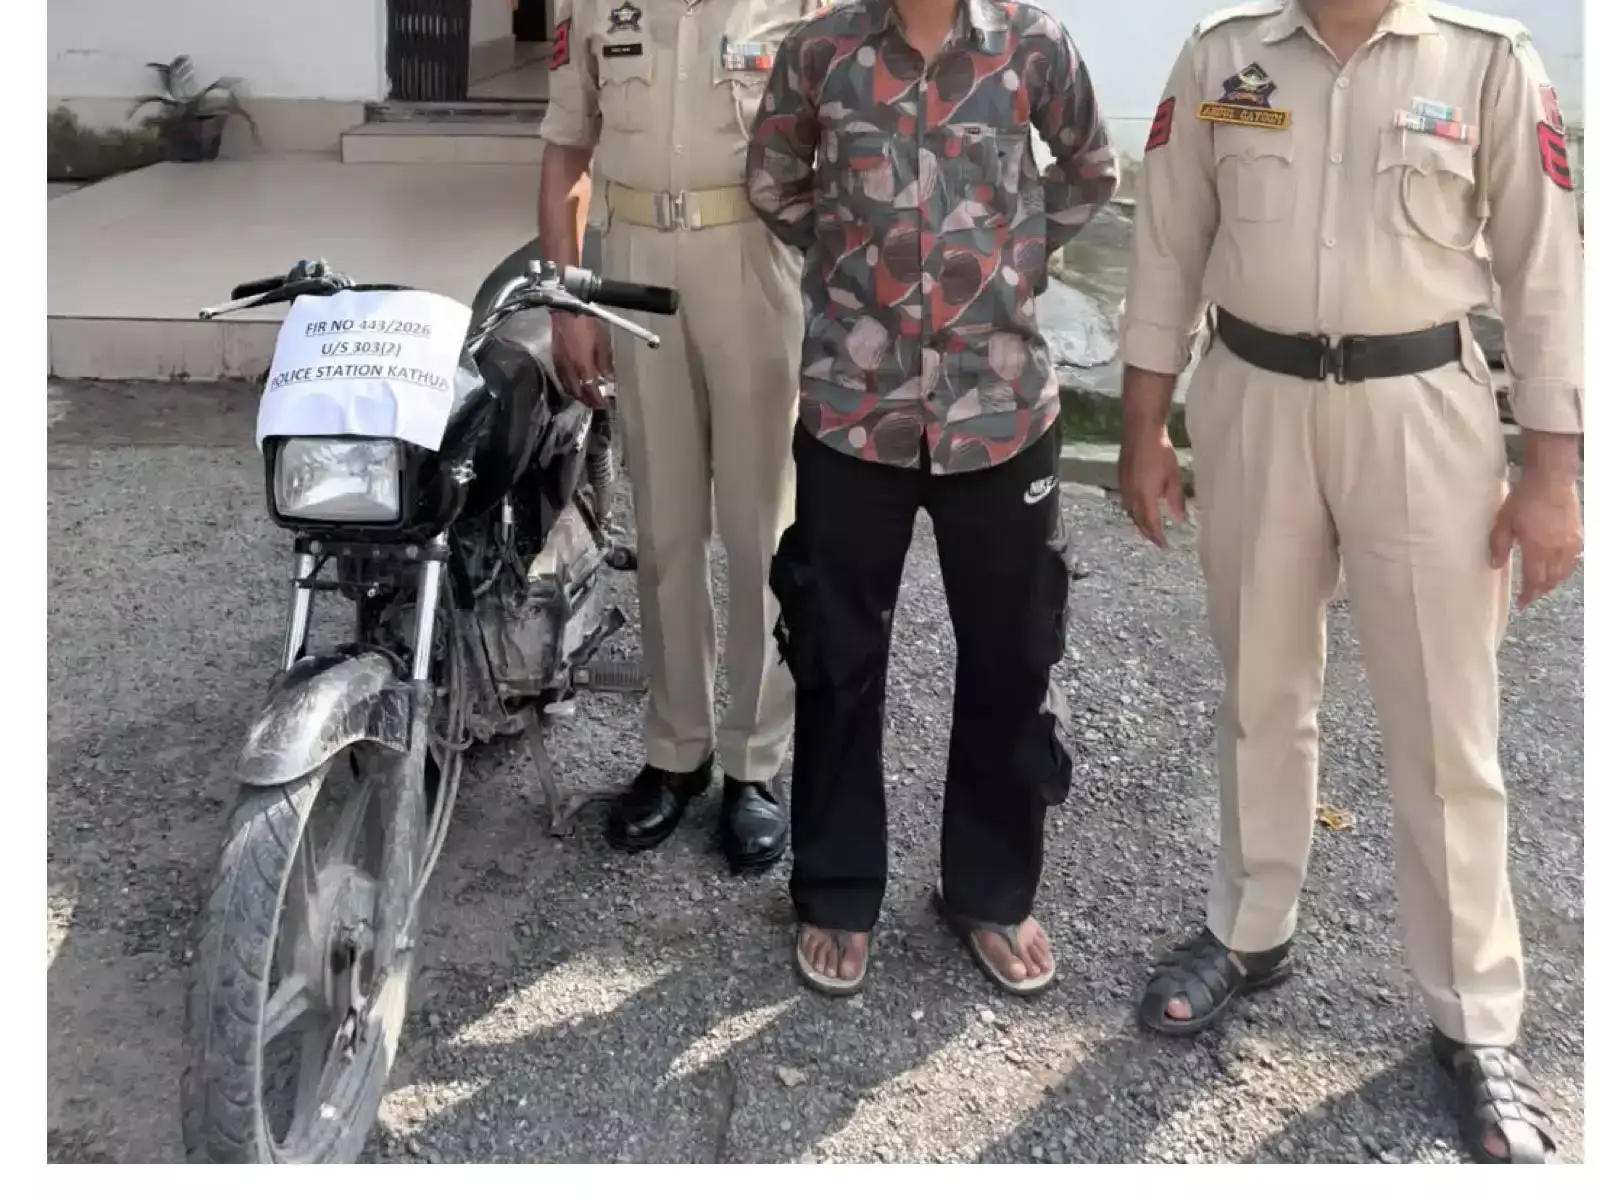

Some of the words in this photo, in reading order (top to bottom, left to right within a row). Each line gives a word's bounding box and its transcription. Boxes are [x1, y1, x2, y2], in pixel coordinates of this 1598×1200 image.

[330, 319, 354, 333] NO
[358, 319, 432, 336] 443/2026
[321, 342, 349, 355] U/S
[352, 342, 402, 357] 303(2)
[272, 367, 313, 389] POLICE
[315, 363, 384, 378] STATION
[387, 364, 449, 389] KATHUA
